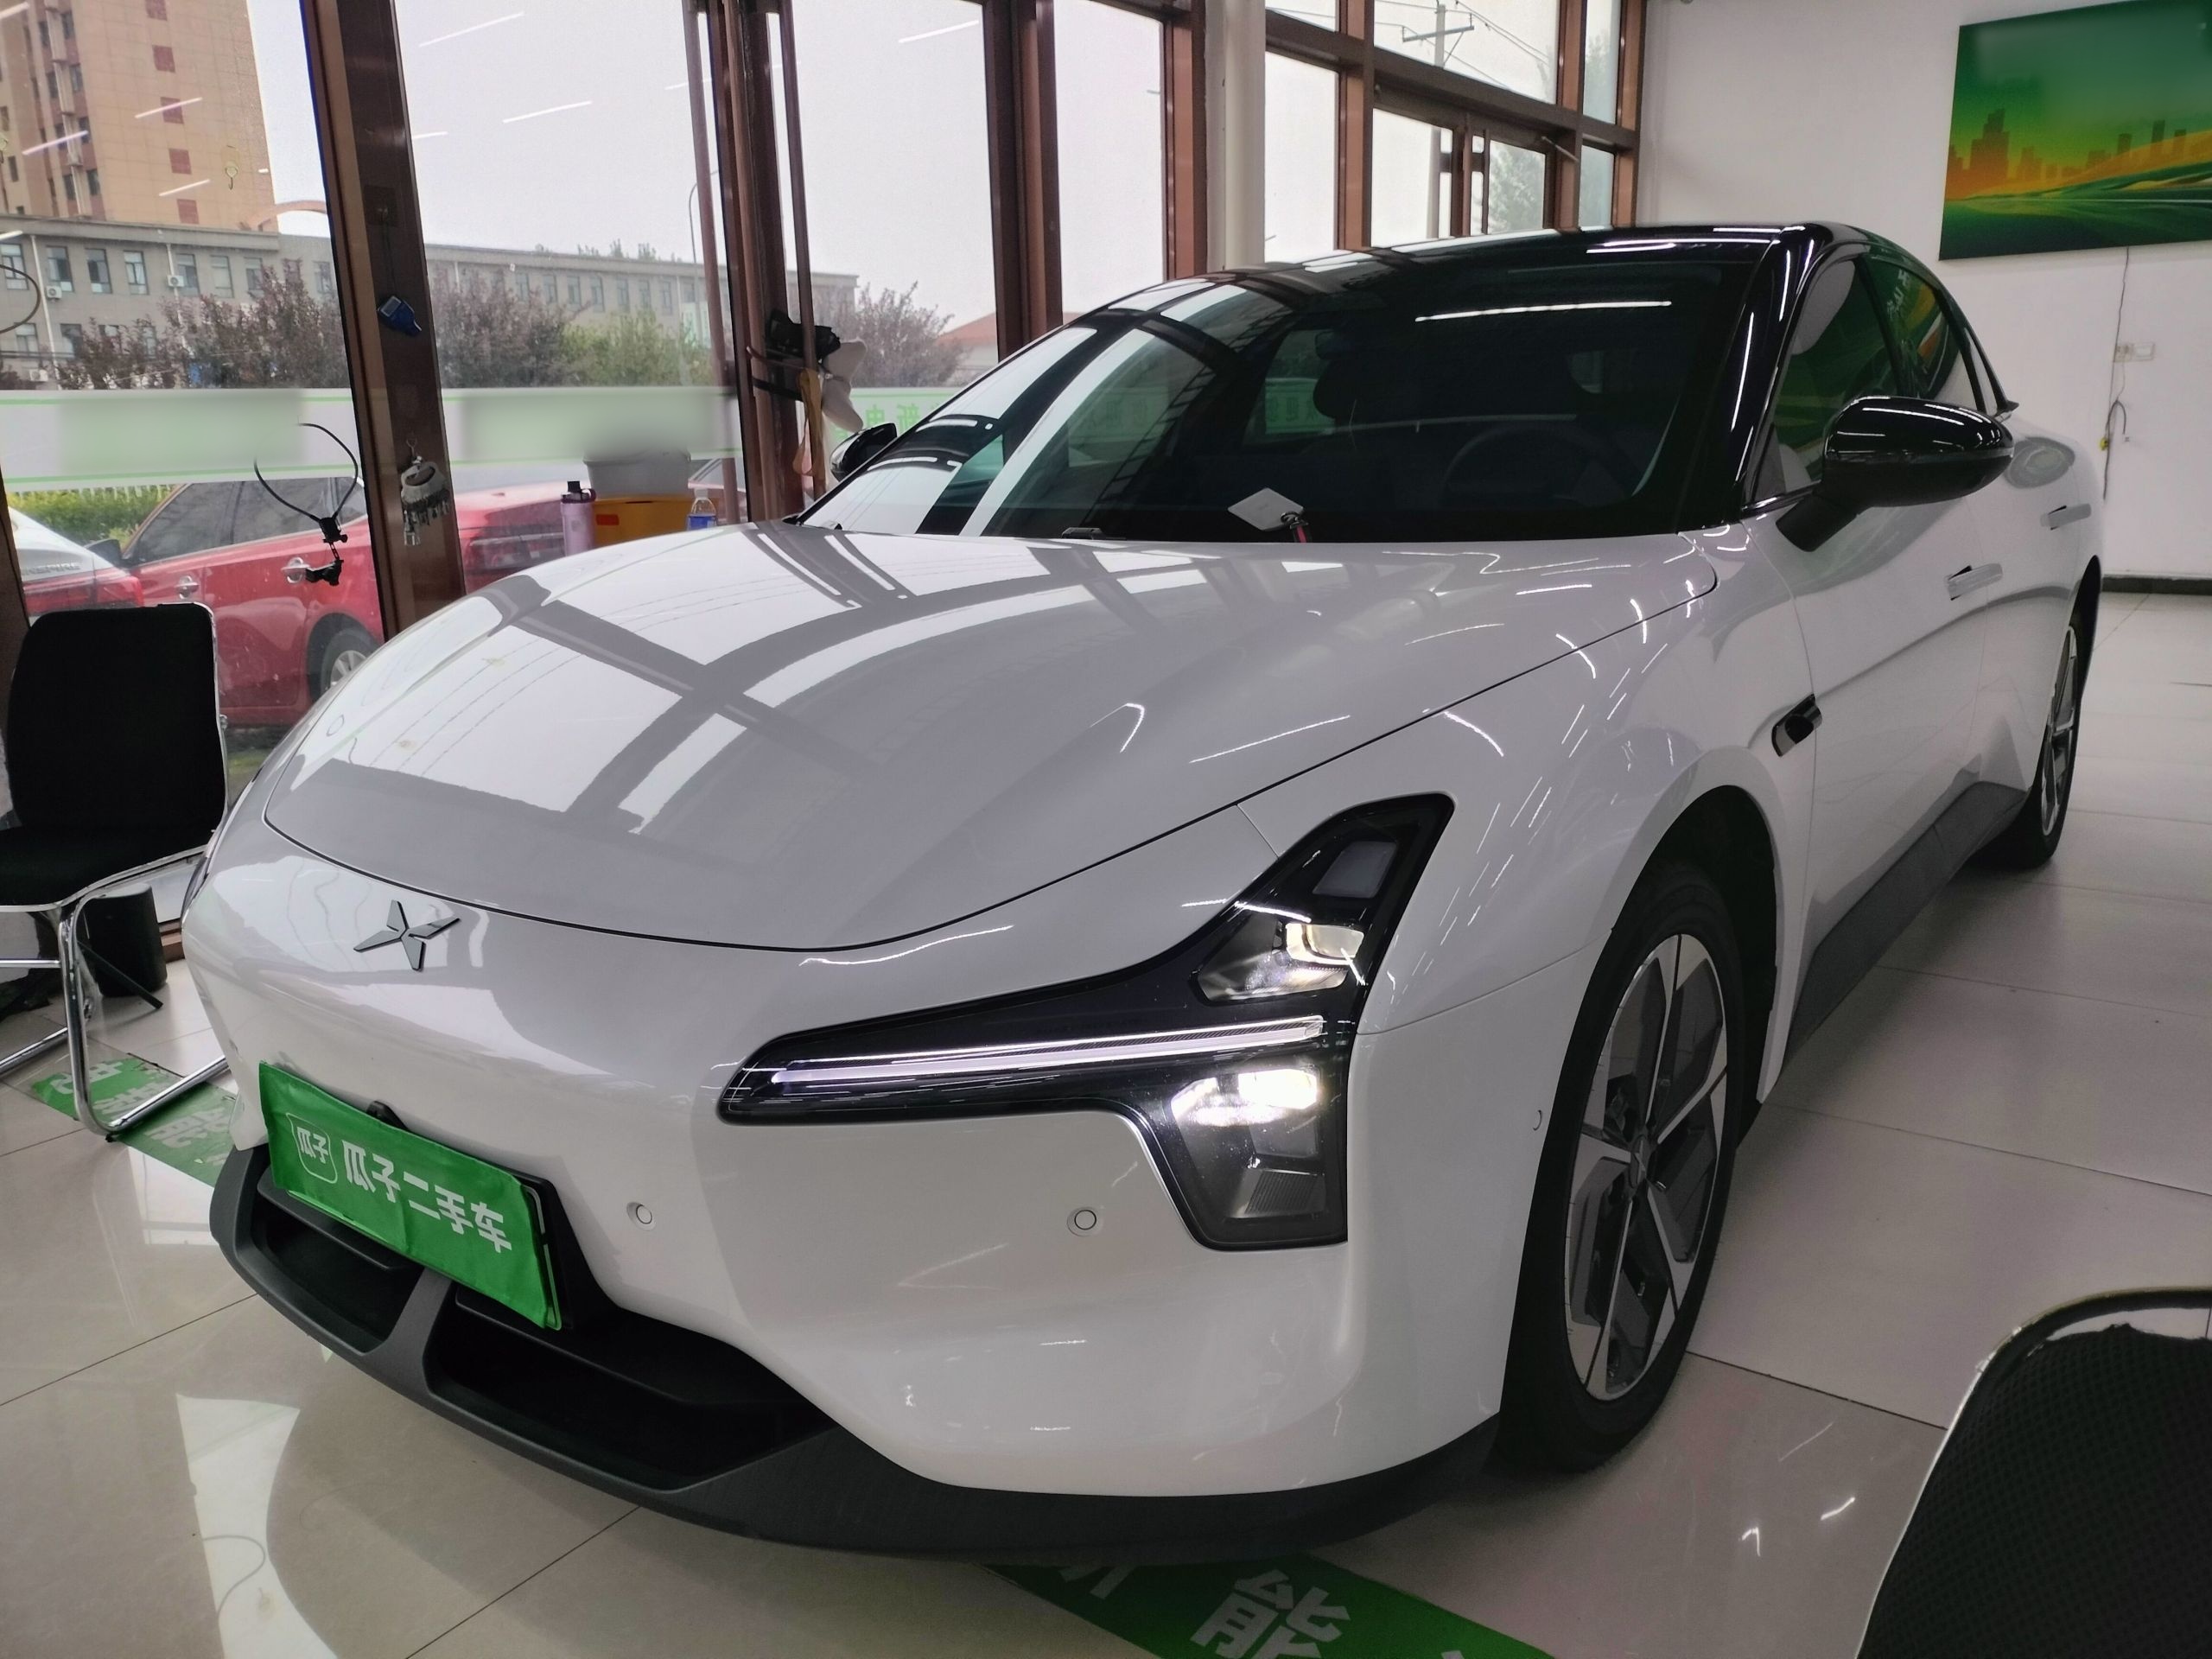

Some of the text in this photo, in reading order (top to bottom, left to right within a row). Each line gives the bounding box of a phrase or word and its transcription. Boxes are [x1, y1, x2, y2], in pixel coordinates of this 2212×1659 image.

[296, 1126, 329, 1164] 瓜子
[342, 1140, 512, 1253] 瓜子二手车
